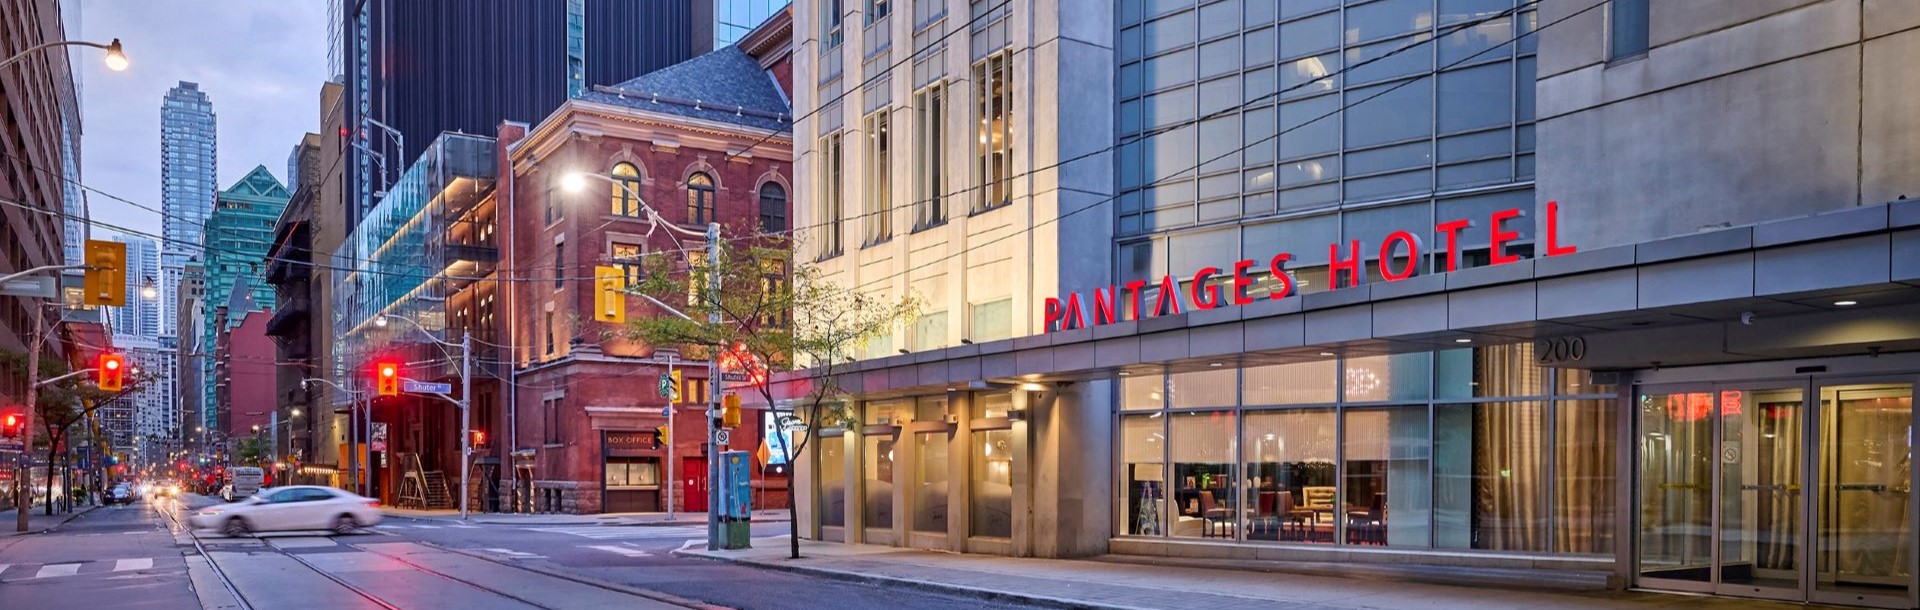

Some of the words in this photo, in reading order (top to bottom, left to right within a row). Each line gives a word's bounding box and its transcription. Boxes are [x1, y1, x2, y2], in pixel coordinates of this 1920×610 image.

[1044, 253, 1297, 333] PANTAGES
[1329, 201, 1577, 289] HOTEL
[1540, 337, 1585, 363] 200
[608, 436, 624, 444] BOX
[626, 436, 652, 444] OFFICE
